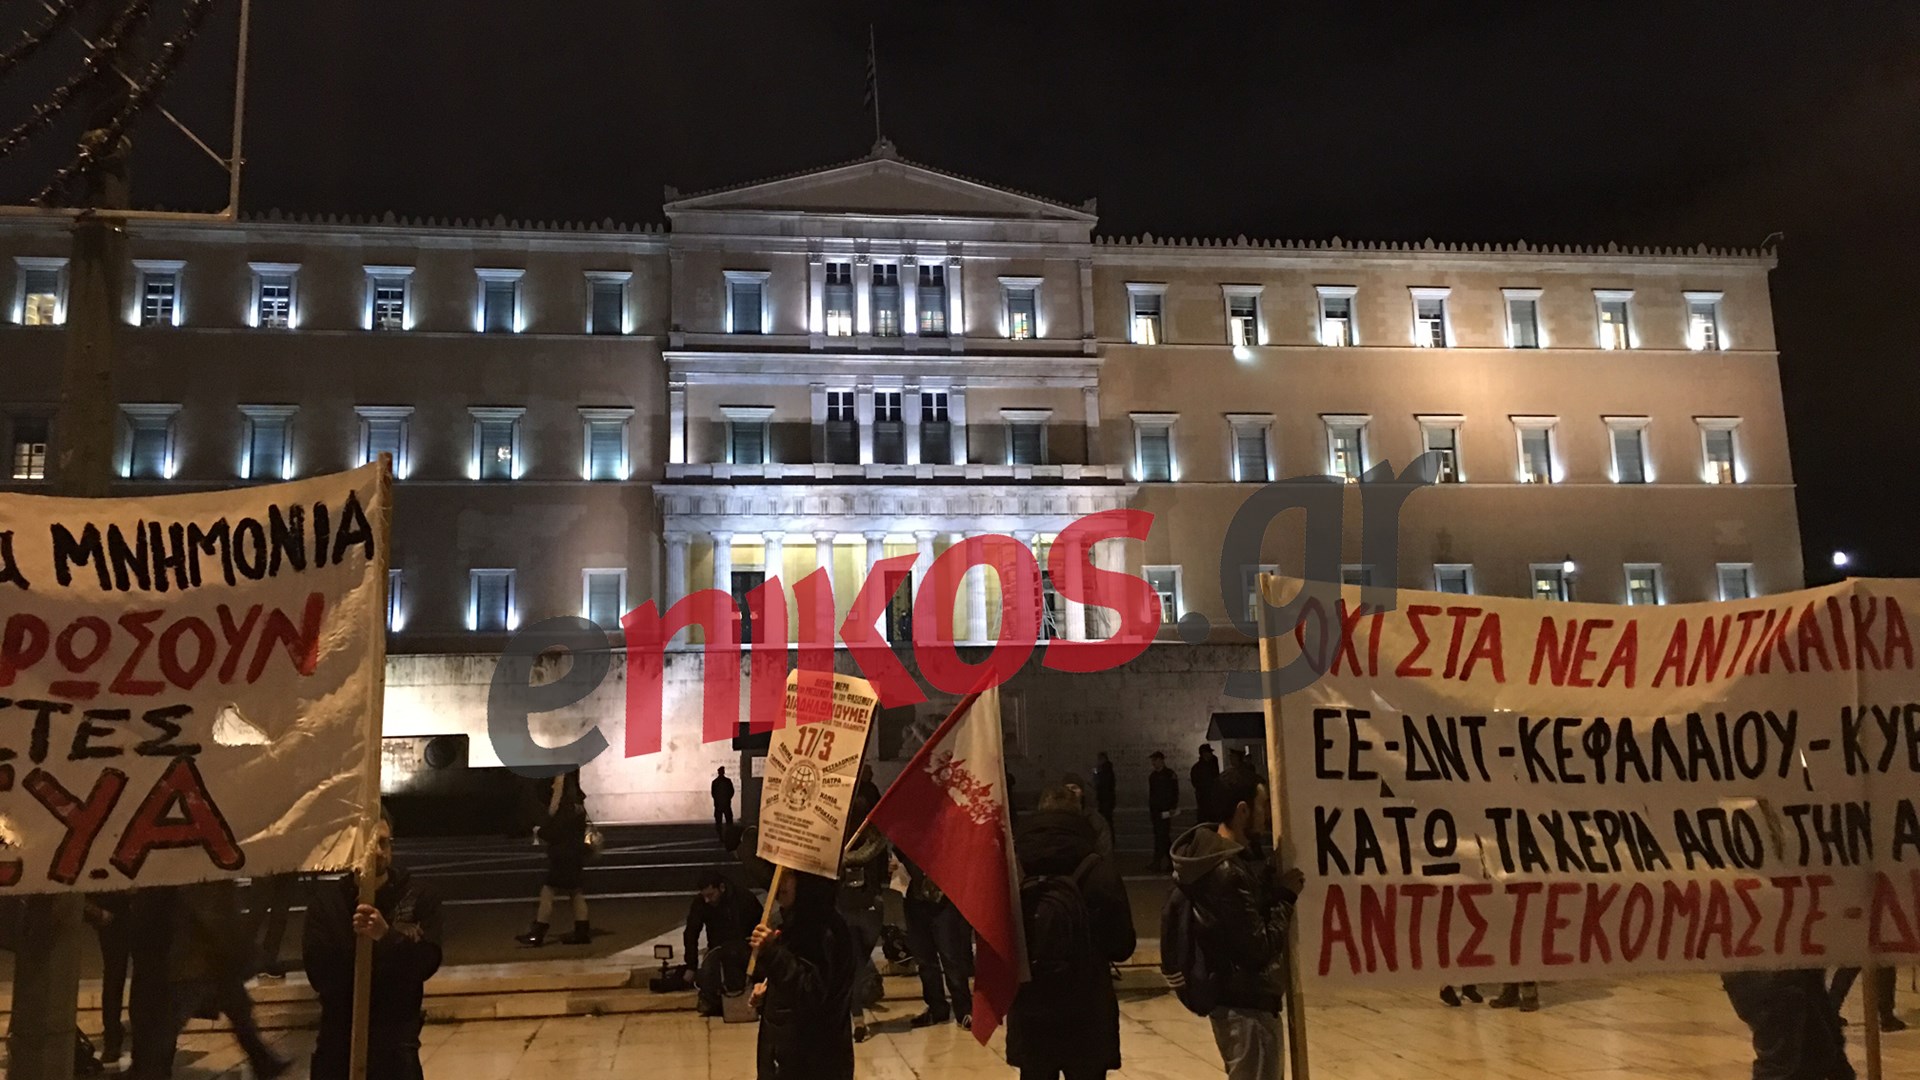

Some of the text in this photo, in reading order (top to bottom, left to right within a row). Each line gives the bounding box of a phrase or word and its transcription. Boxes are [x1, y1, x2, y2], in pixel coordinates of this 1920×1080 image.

[50, 490, 375, 592] ΜΝΗΜΟΝΙΑ
[1294, 597, 1385, 677] ΟΧΙ
[1395, 604, 1506, 683] ΣΤΑ
[1528, 616, 1638, 689] ΝΕΑ
[793, 726, 836, 762] 17/3
[822, 777, 842, 785] ΠΑΤΡΑ
[1673, 806, 1765, 870] ΑΠΟ
[1783, 801, 1874, 867] ΤΗΝ
